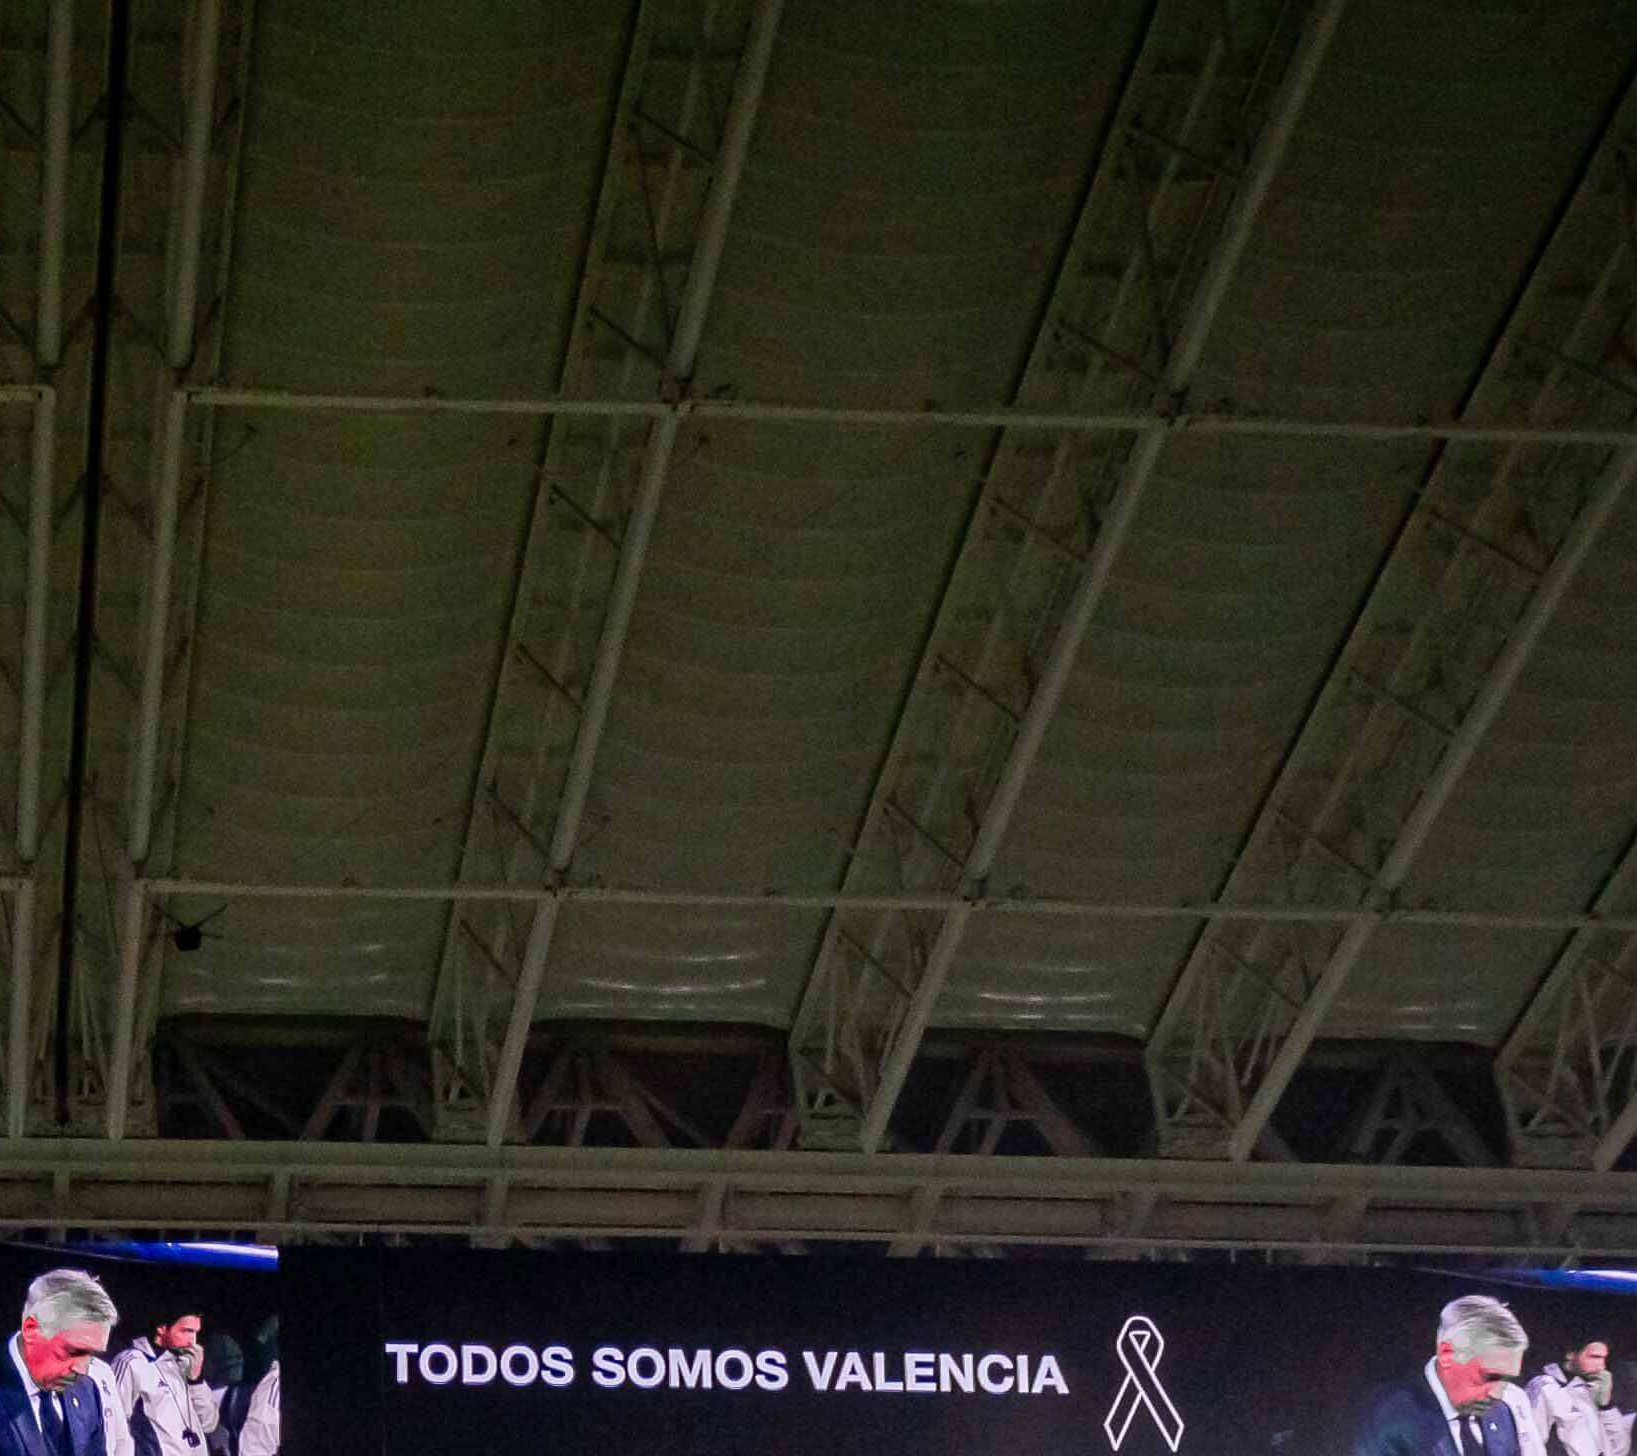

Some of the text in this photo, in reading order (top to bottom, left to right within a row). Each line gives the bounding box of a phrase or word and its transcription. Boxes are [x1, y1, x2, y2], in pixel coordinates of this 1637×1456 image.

[385, 1343, 1070, 1395] TODOS SOMOS VALENCIA
